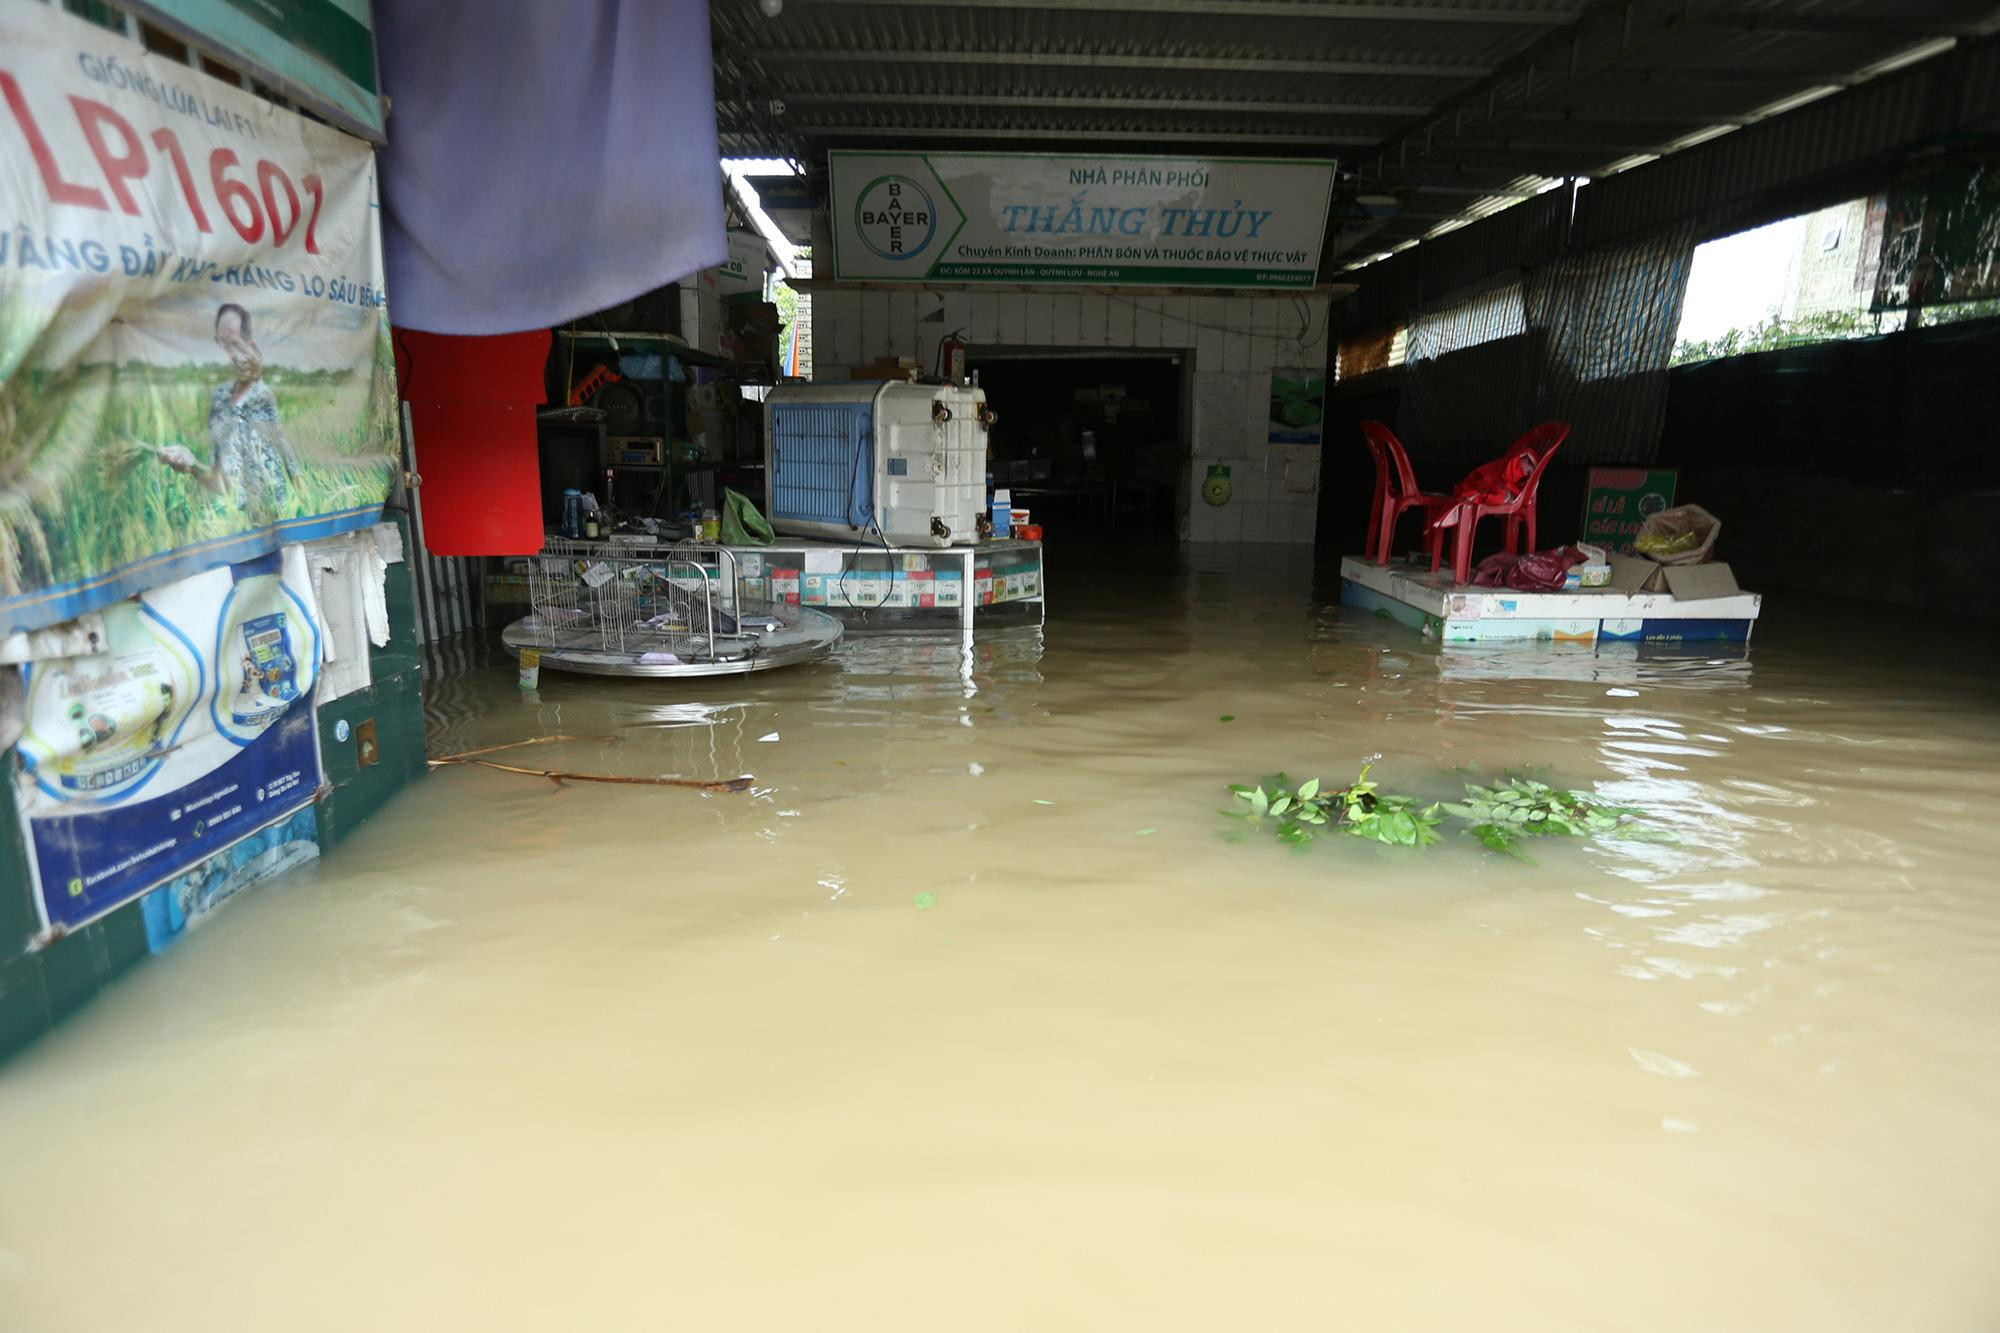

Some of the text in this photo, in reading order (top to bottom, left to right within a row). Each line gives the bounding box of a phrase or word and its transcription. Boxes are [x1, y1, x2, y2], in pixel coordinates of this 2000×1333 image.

[0, 70, 324, 255] LP1601
[1069, 167, 1209, 188] NHÀ PHÂN PHỐI
[862, 212, 929, 225] BAYER
[888, 183, 903, 253] BAYER
[1002, 190, 1273, 238] THẮNG THỦY
[957, 244, 1309, 265] Chuyên Kinh Doanh: PHÂN BÓN VÀ THUỐC BẢO VỆ THỰC VẬT
[300, 273, 325, 298] LO
[328, 275, 359, 305] SÂU
